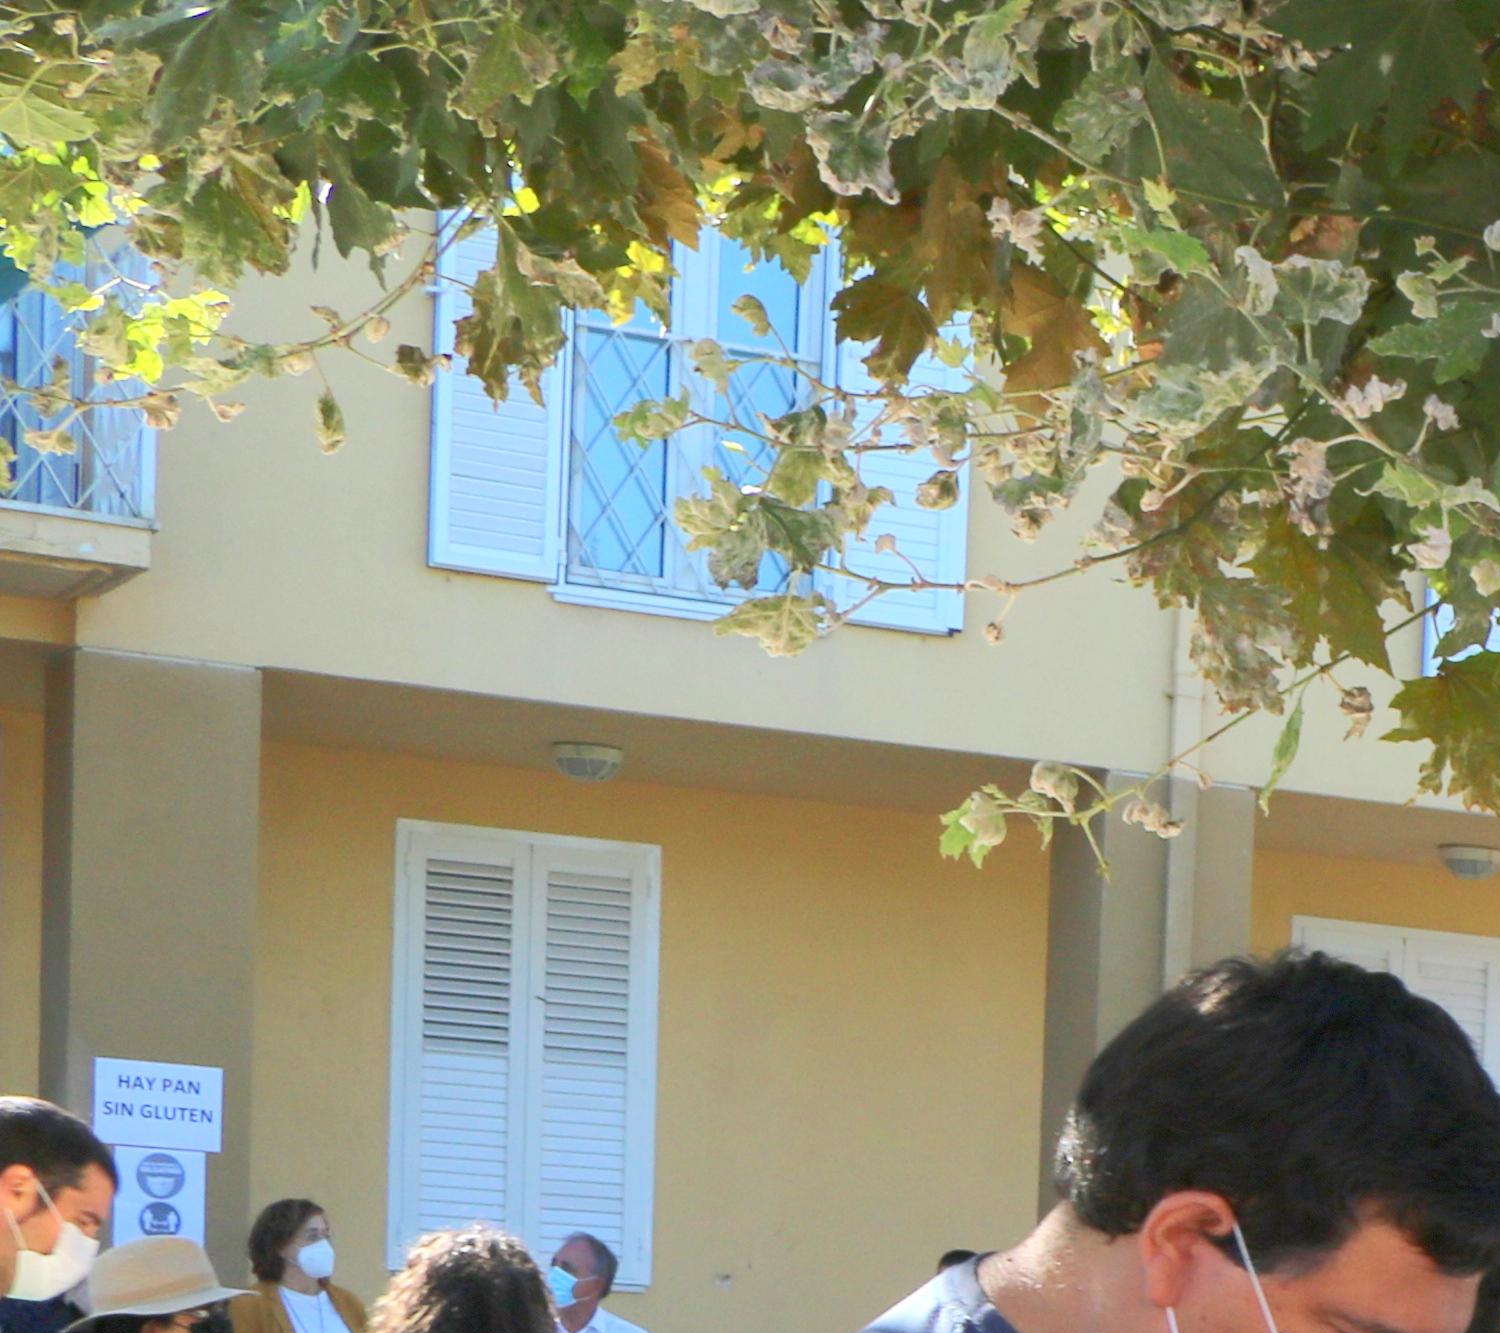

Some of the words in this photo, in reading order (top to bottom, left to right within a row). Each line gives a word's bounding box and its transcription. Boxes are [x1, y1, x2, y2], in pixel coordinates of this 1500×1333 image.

[118, 1074, 157, 1092] HAY
[162, 1078, 201, 1095] PAN
[103, 1101, 134, 1117] SIN
[140, 1104, 214, 1124] GLUTEN
